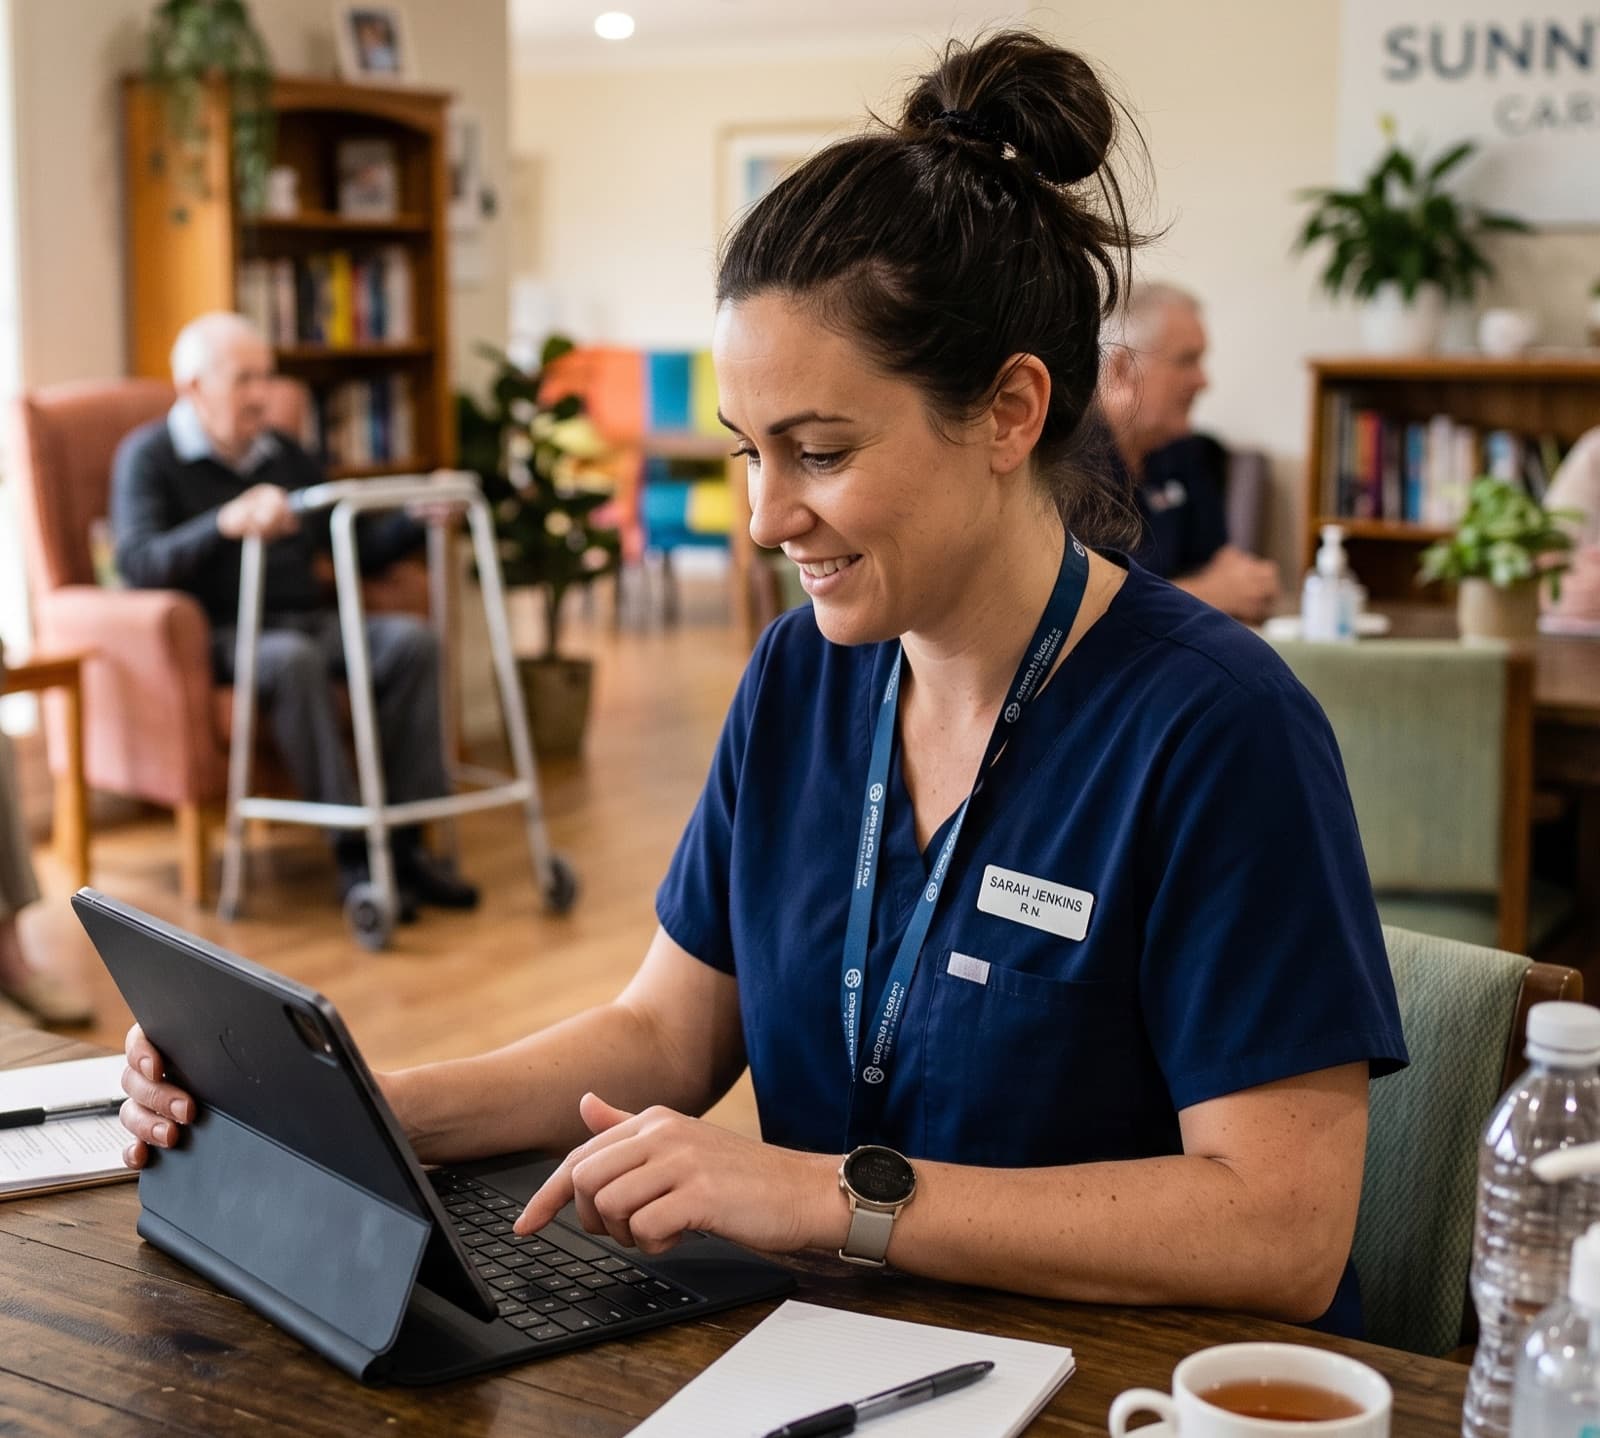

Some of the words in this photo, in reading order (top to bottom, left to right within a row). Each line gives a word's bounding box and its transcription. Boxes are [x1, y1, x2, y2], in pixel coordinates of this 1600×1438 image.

[1383, 18, 1597, 82] SUNN
[990, 876, 1030, 897] SARAH
[1032, 889, 1083, 912] JENKINS
